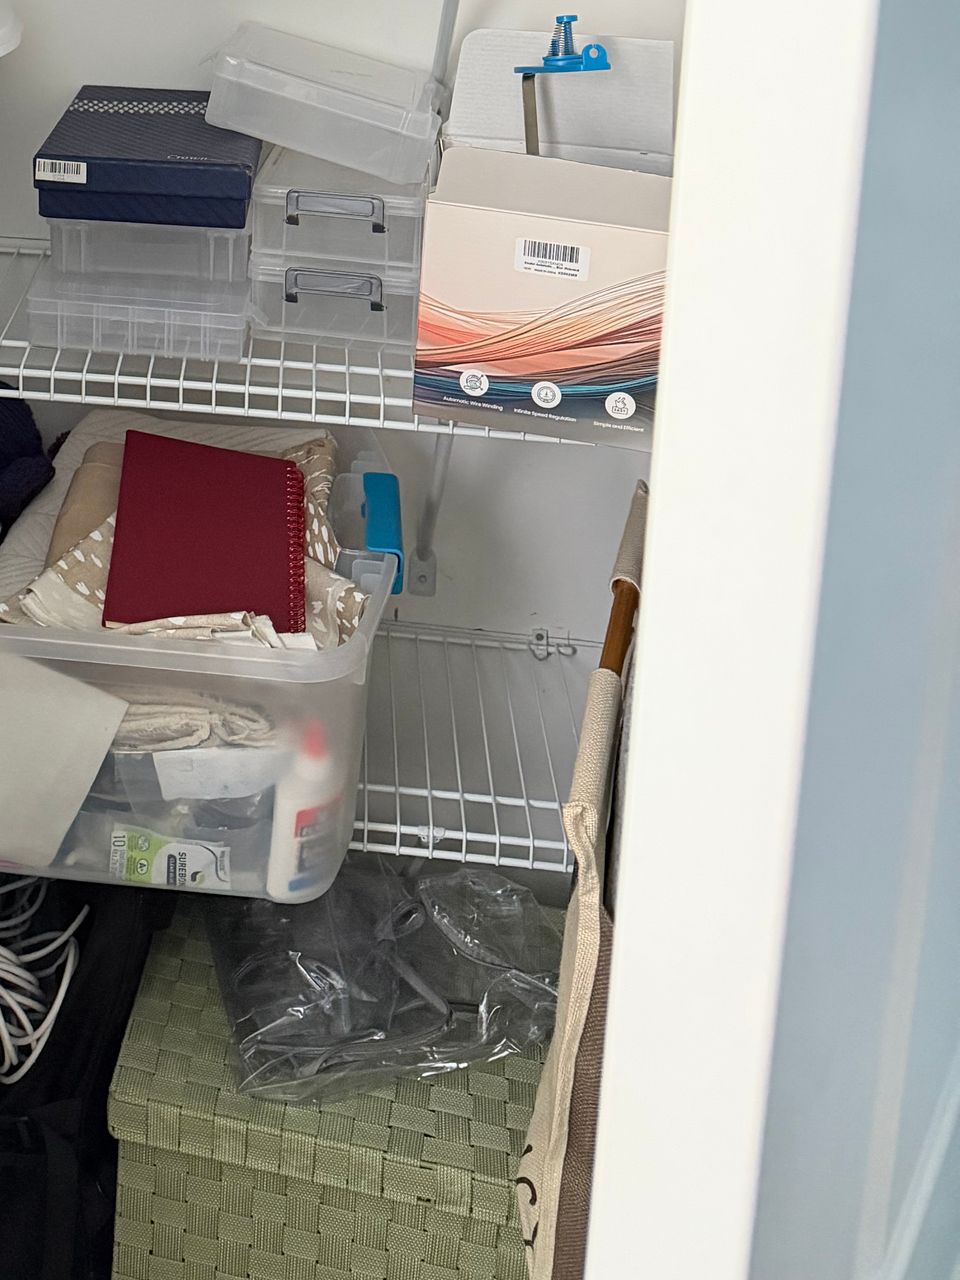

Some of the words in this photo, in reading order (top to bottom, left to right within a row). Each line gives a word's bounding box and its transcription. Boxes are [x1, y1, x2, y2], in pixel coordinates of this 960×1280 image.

[443, 396, 470, 405] Automatic
[482, 402, 504, 412] Winding
[531, 410, 548, 419] Speed
[549, 413, 577, 422] Regulation
[113, 835, 126, 847] 10
